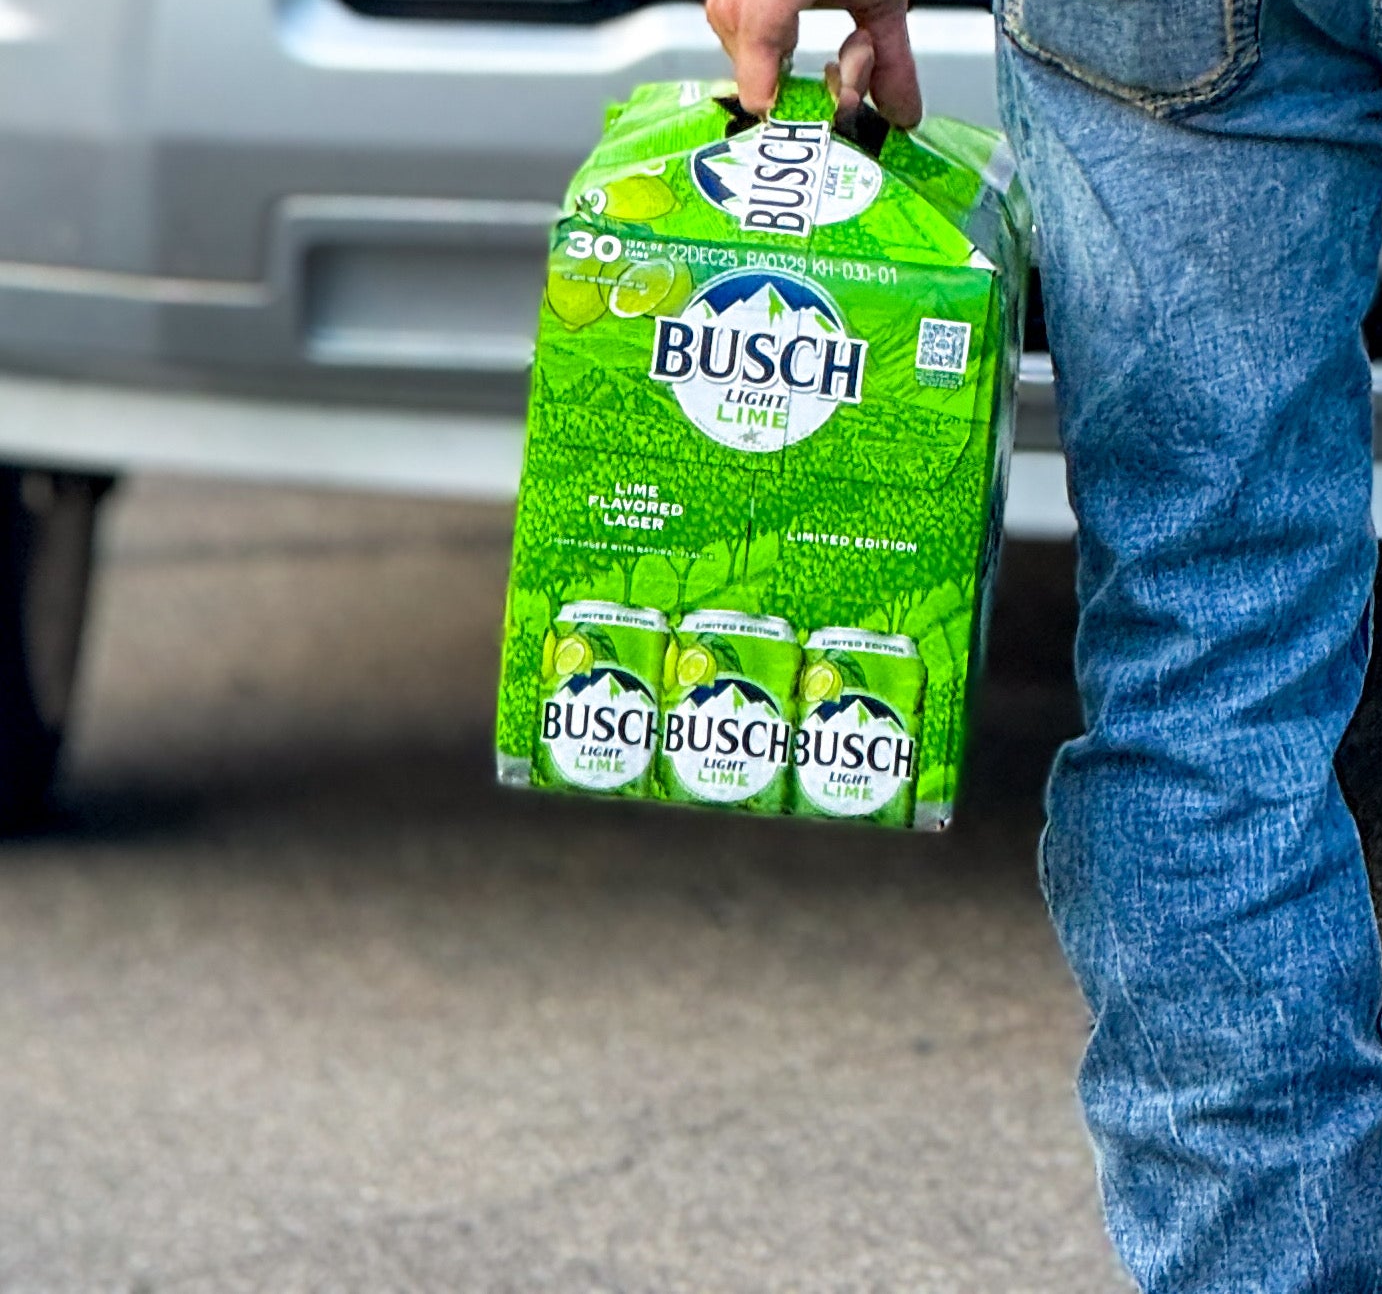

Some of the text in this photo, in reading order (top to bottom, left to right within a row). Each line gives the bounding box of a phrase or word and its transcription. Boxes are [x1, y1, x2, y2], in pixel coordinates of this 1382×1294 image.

[744, 120, 826, 235] BUSCH
[838, 164, 859, 200] LIME
[565, 230, 622, 263] 30
[668, 243, 738, 268] 22DEC25
[812, 259, 898, 285] KH-030-01
[653, 318, 864, 400] BUSCH
[725, 388, 788, 409] LIGHT
[716, 404, 787, 430] LIME
[614, 481, 660, 499] LIME
[588, 494, 684, 517] FLAVORED
[603, 513, 665, 531] LAGER
[786, 531, 918, 554] LIMITED EDITION
[664, 713, 790, 764] BUSCH
[579, 744, 623, 759] LIGHT
[794, 728, 915, 778] BUSCH
[574, 756, 625, 774] LIME
[703, 757, 747, 772] LIGHT
[697, 769, 750, 788] LIME
[829, 771, 872, 786] LIGHT
[822, 783, 875, 801] LIME
